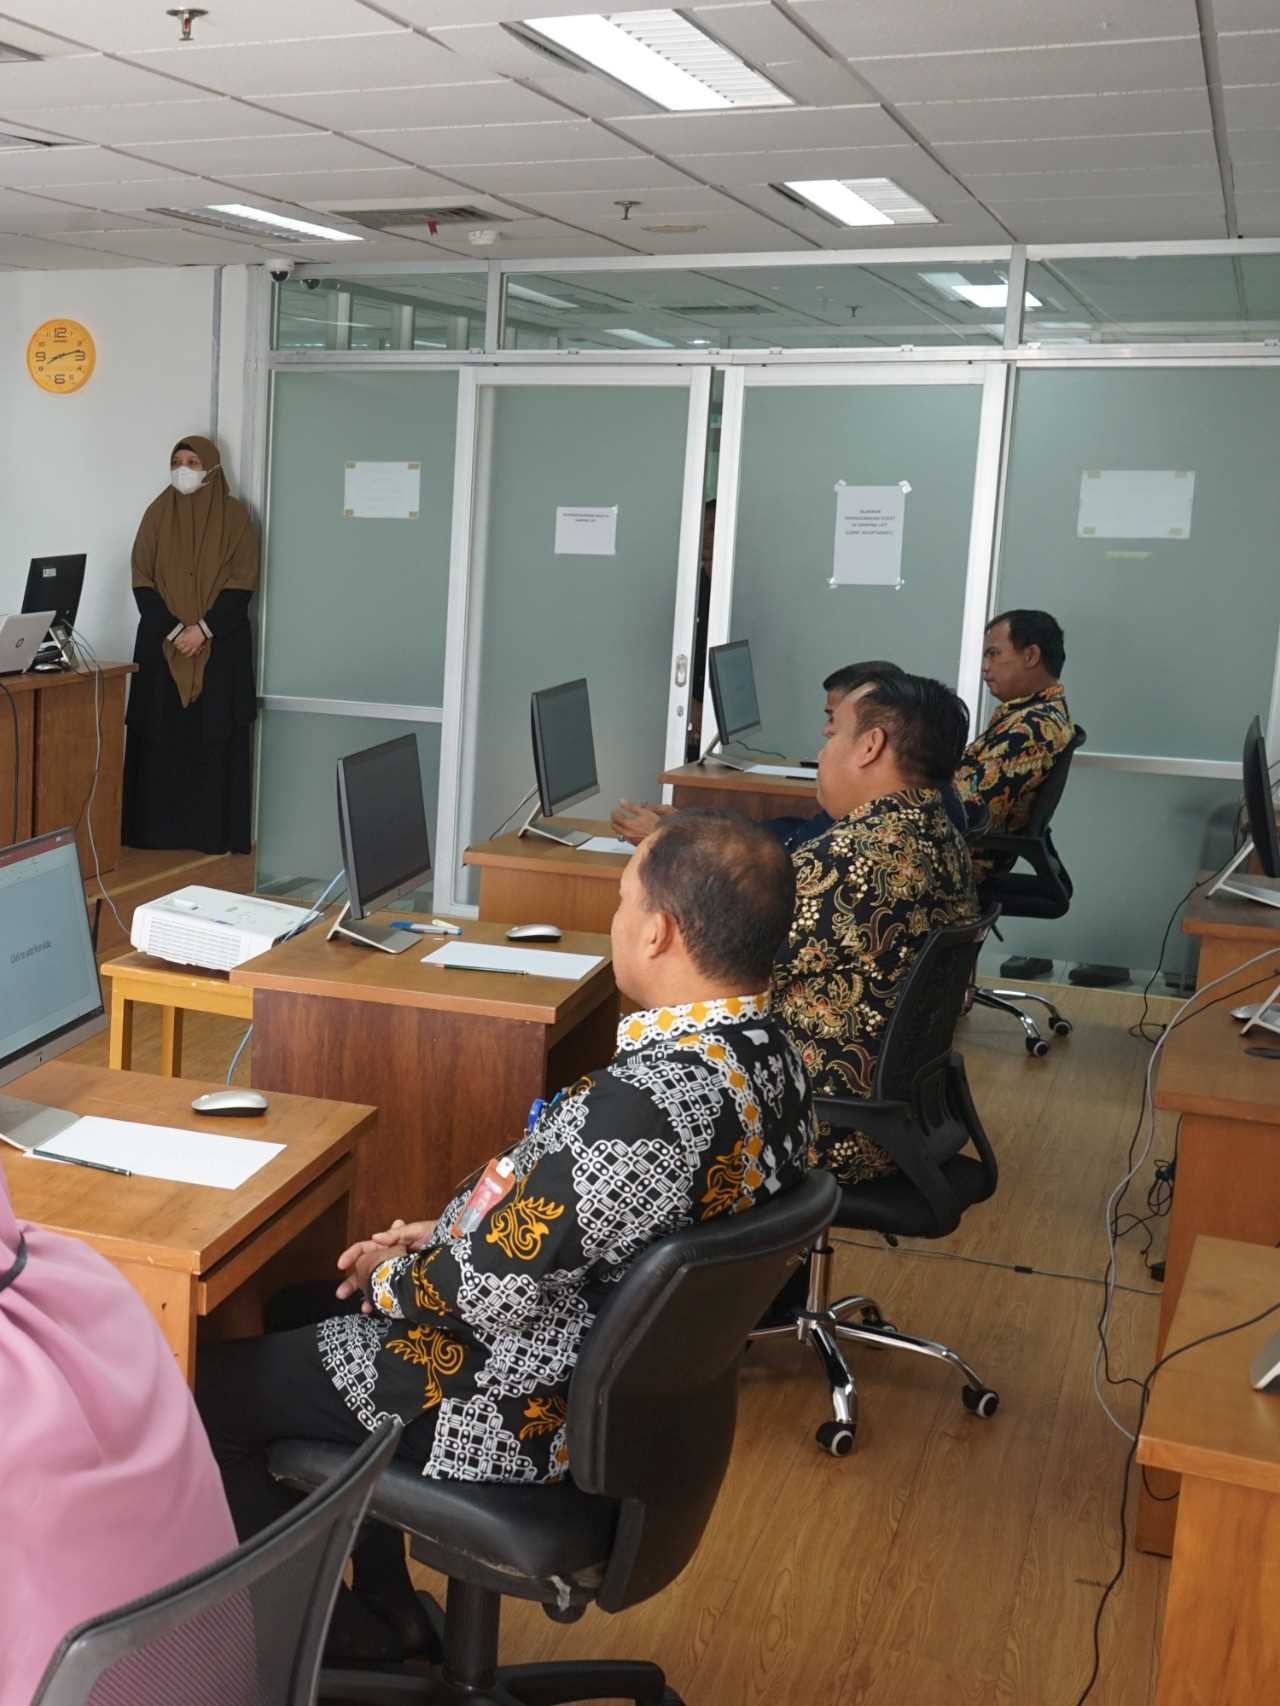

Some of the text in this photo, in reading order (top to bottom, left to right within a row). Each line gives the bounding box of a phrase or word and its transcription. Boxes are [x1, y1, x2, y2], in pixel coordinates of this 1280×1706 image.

[54, 327, 68, 339] 12
[35, 351, 46, 362] 9
[54, 374, 66, 385] 6
